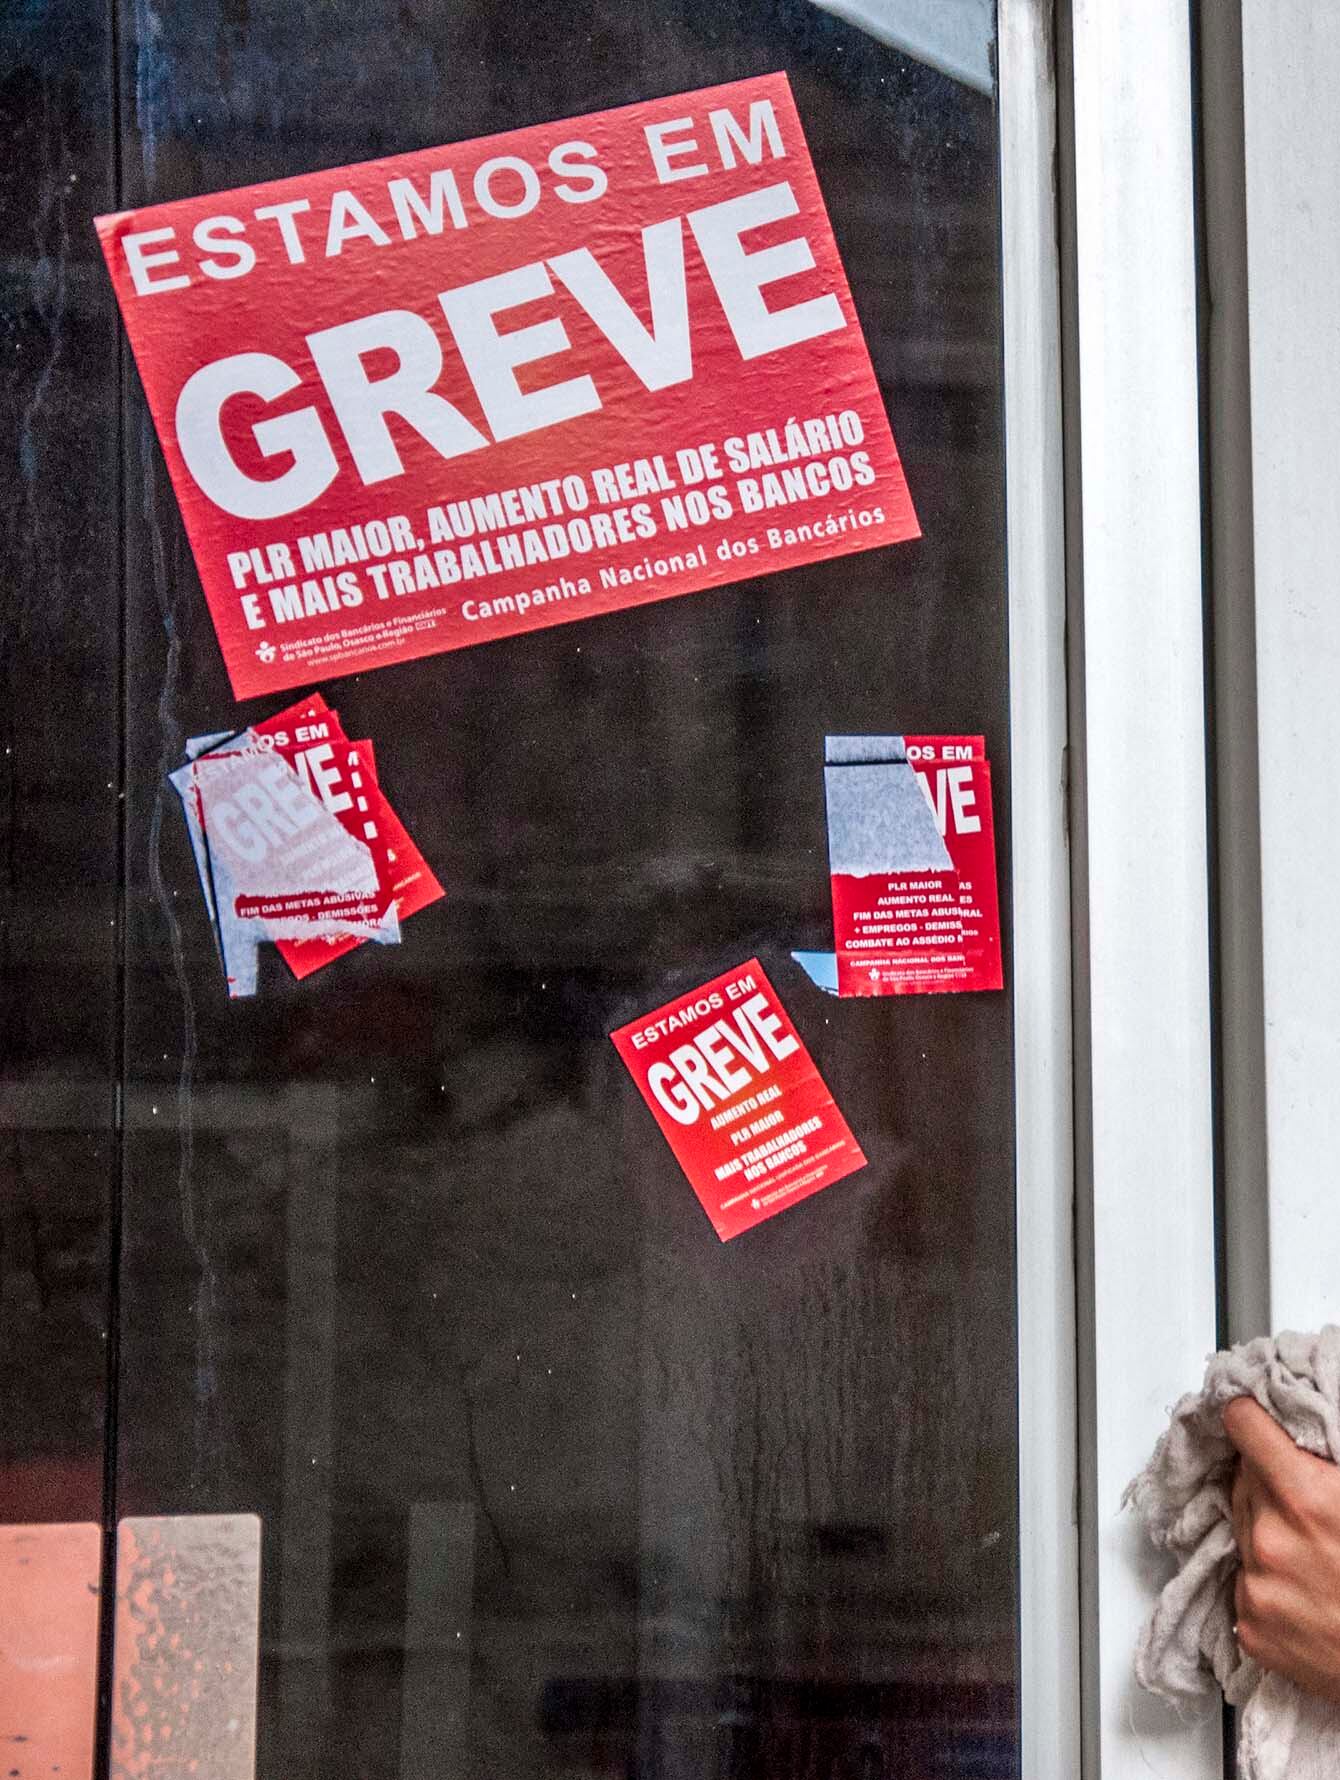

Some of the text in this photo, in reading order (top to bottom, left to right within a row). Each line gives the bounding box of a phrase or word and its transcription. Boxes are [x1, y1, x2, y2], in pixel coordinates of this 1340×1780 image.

[122, 99, 788, 297] ESTAMOS EM
[175, 181, 848, 521] GREVE
[226, 409, 865, 589] PLR MAIOR, AUMENTO REAL DE SALÁRIO
[240, 450, 876, 630] E MAIS TRABALHADORES NOS BANCOS
[461, 504, 886, 622] Campanha Nacional dos Bancários
[280, 635, 322, 653] Sindicato
[324, 630, 341, 643] dos
[343, 633, 375, 648] Osasco
[295, 722, 329, 743] EM
[942, 746, 973, 760] EM
[877, 893, 955, 906] AUMENTO REAL
[888, 880, 942, 892] PLR MAIOR
[240, 906, 260, 917] FIM
[262, 902, 283, 914] DAS
[285, 897, 321, 911] METAS
[853, 911, 871, 921] FIM
[873, 910, 893, 920] DAS
[895, 908, 929, 919] METAS
[845, 937, 894, 949] COMBATE
[895, 936, 910, 947] AO
[912, 933, 955, 946] ASSÉDIO
[862, 922, 918, 935] EMPREGOS
[630, 975, 757, 1050] ESTAMOS EM
[647, 992, 800, 1126] GREVE
[710, 1084, 782, 1130] AUMENTO REAL
[730, 1110, 784, 1146] PLR MAIOR
[714, 1158, 743, 1181] MAIS
[740, 1116, 823, 1166] TRABALHADORES
[744, 1140, 808, 1182] NOS BANCOS
